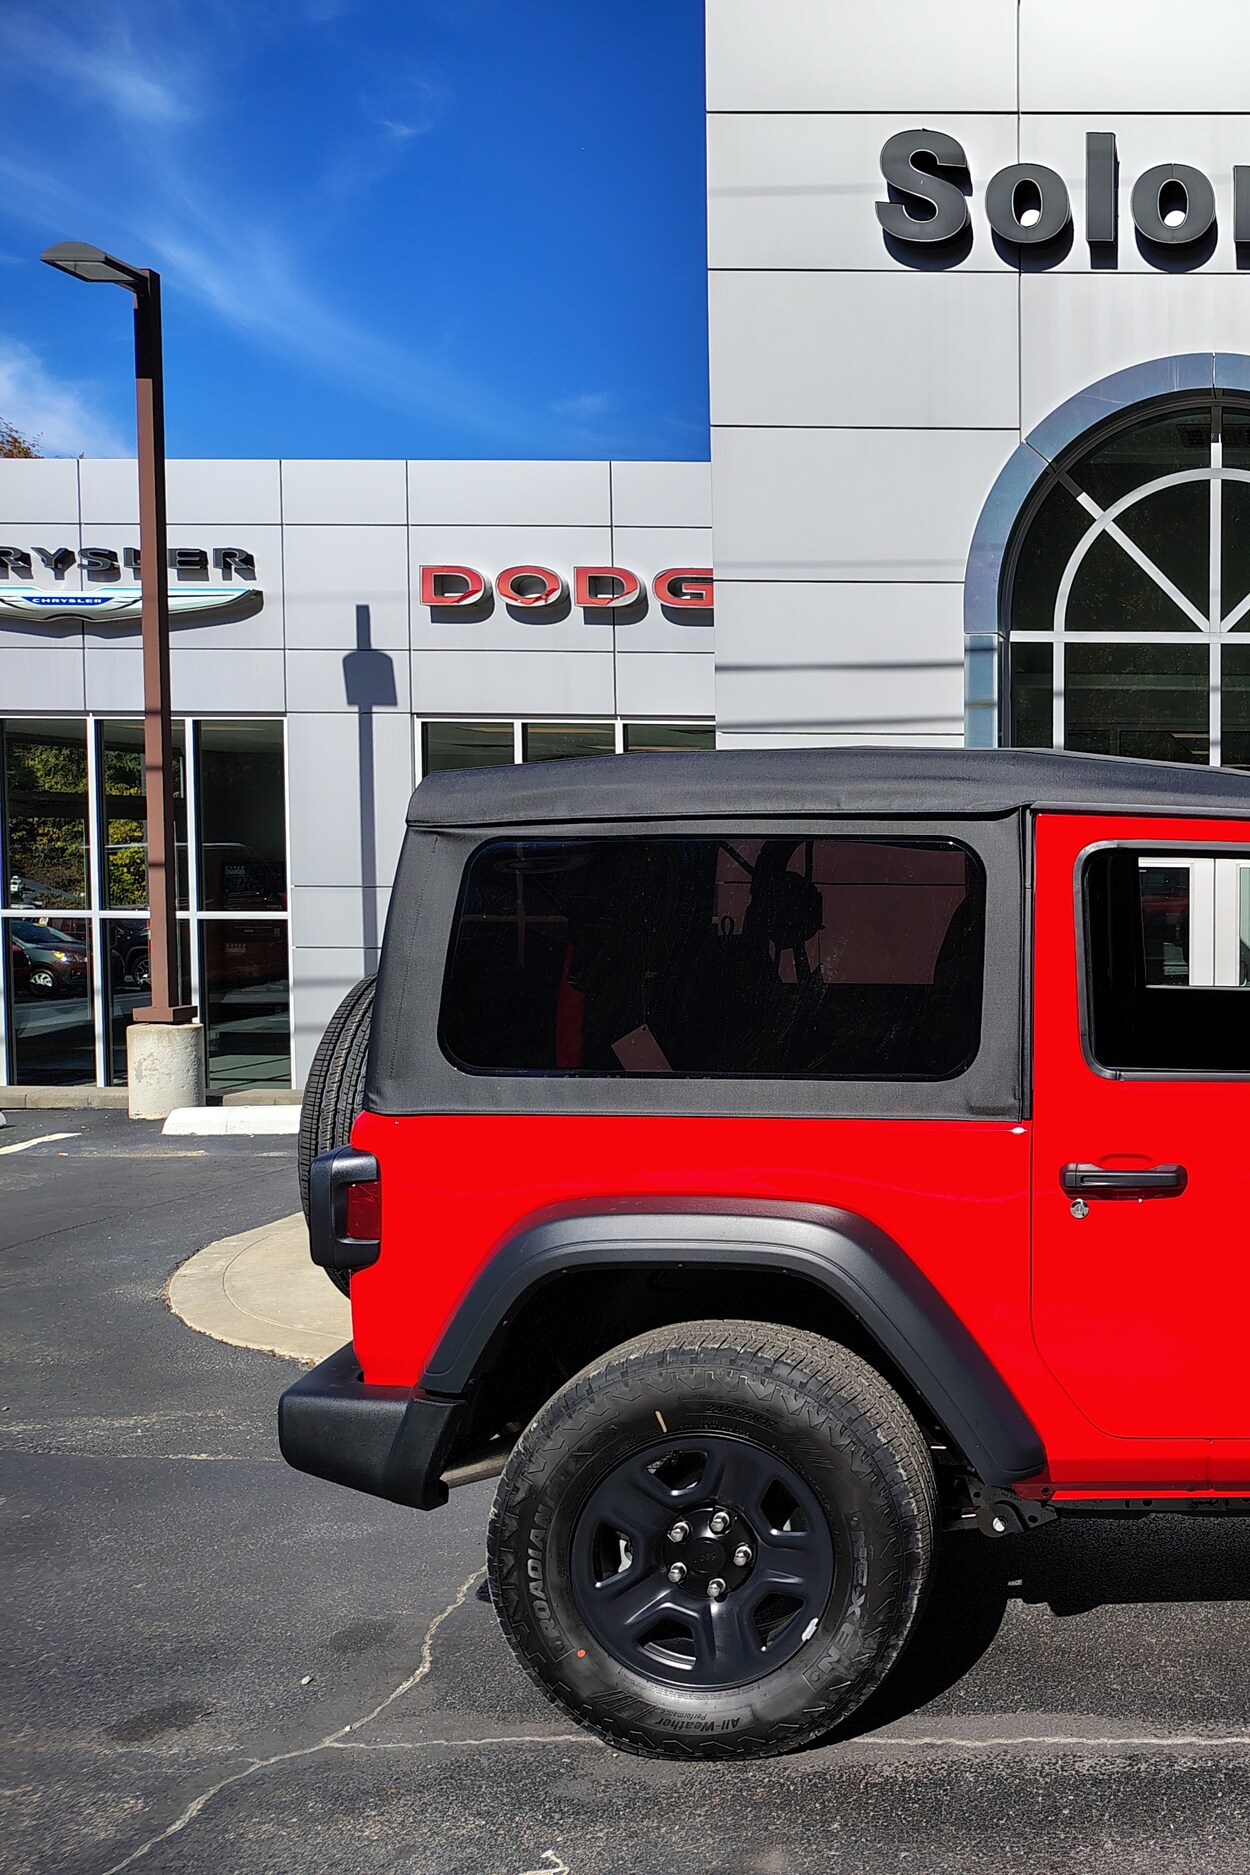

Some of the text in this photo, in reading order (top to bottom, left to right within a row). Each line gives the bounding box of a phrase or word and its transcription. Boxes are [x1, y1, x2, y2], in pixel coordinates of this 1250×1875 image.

[419, 564, 714, 608] DODG
[527, 1503, 561, 1638] ROADIAN
[654, 1716, 741, 1732] All-Weather
